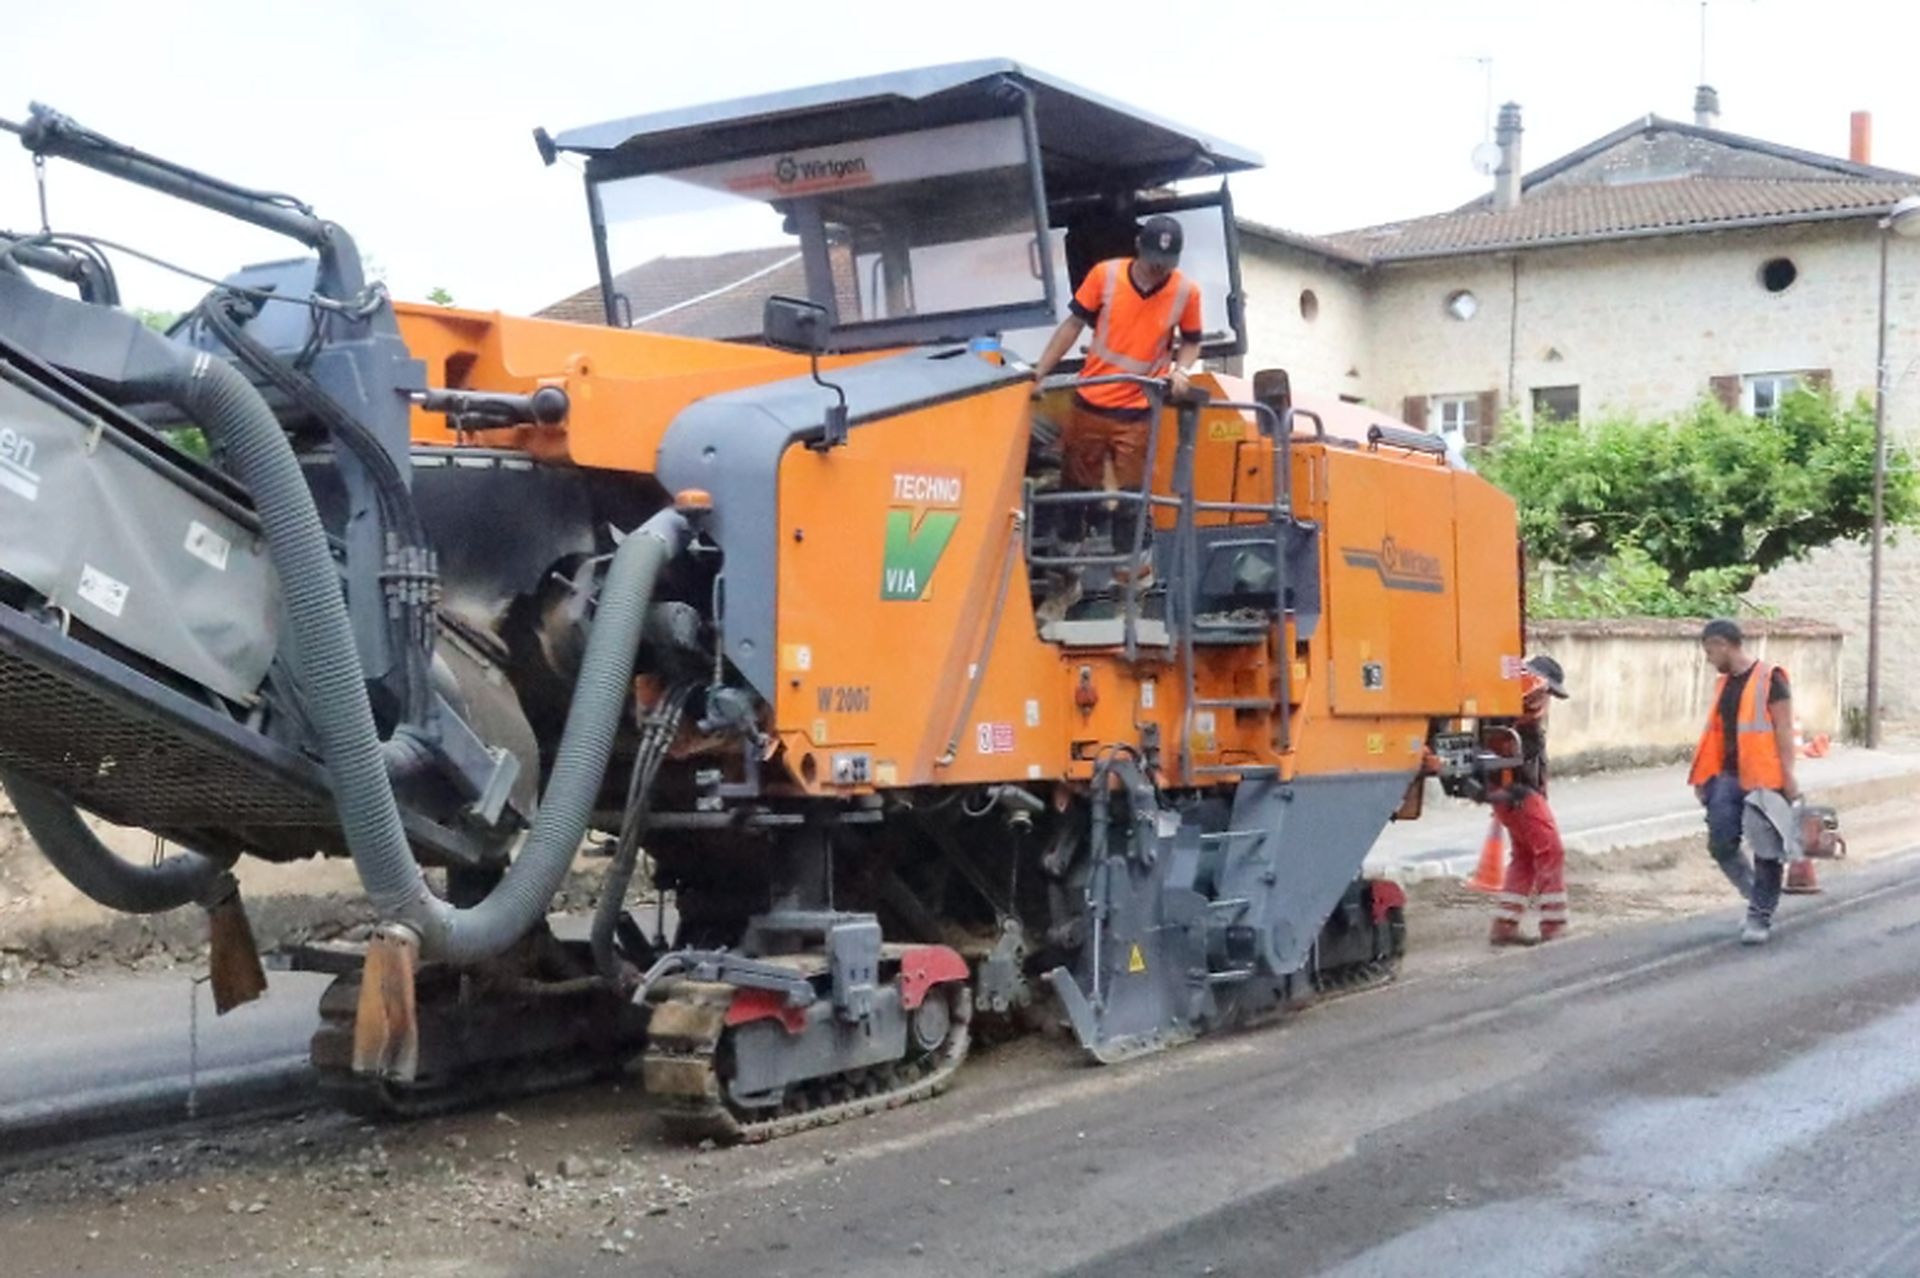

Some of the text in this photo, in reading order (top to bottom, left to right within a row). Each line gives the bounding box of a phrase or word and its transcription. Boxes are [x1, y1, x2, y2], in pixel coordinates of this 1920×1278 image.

[800, 157, 865, 178] Wirtgen
[894, 474, 961, 501] TECHNO
[886, 569, 916, 592] VIA
[817, 686, 834, 712] W
